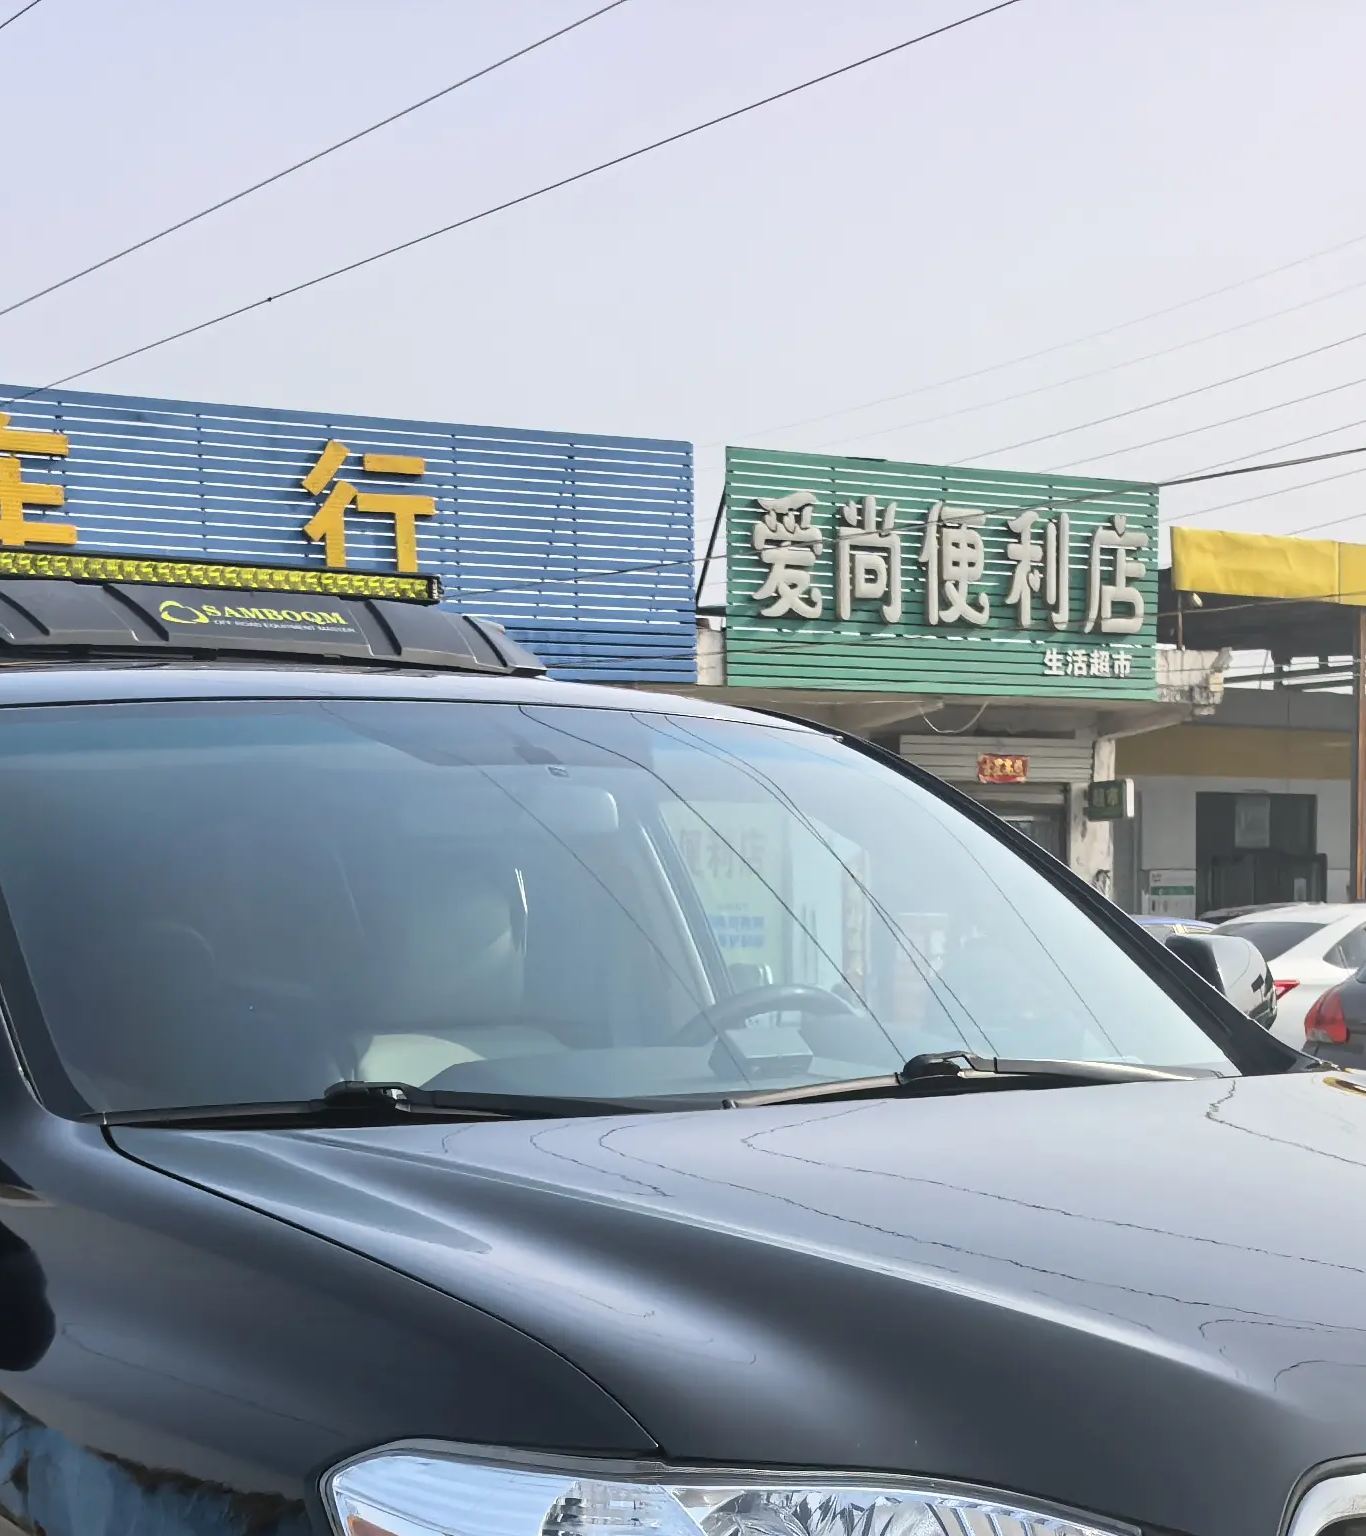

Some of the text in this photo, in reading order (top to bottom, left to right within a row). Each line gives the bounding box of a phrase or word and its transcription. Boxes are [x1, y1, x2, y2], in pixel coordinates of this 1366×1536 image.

[752, 491, 1149, 636] 爱尚便利店
[1044, 648, 1132, 677] 生活超市
